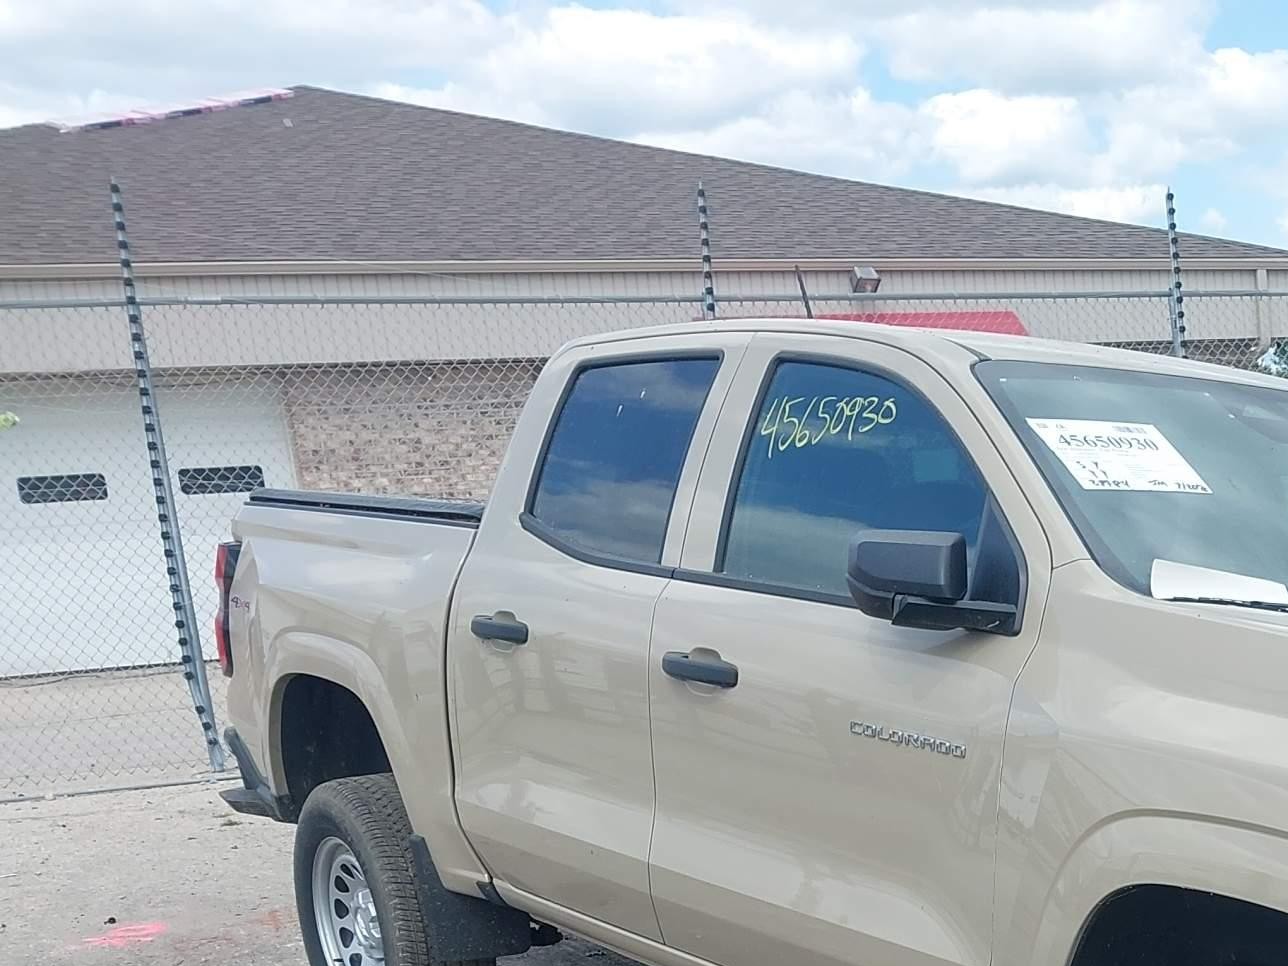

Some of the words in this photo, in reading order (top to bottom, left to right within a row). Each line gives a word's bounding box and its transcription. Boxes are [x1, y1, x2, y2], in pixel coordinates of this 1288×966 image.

[761, 396, 898, 459] 45650930
[1058, 434, 1160, 452] 45650930
[849, 720, 967, 759] COLORADO
